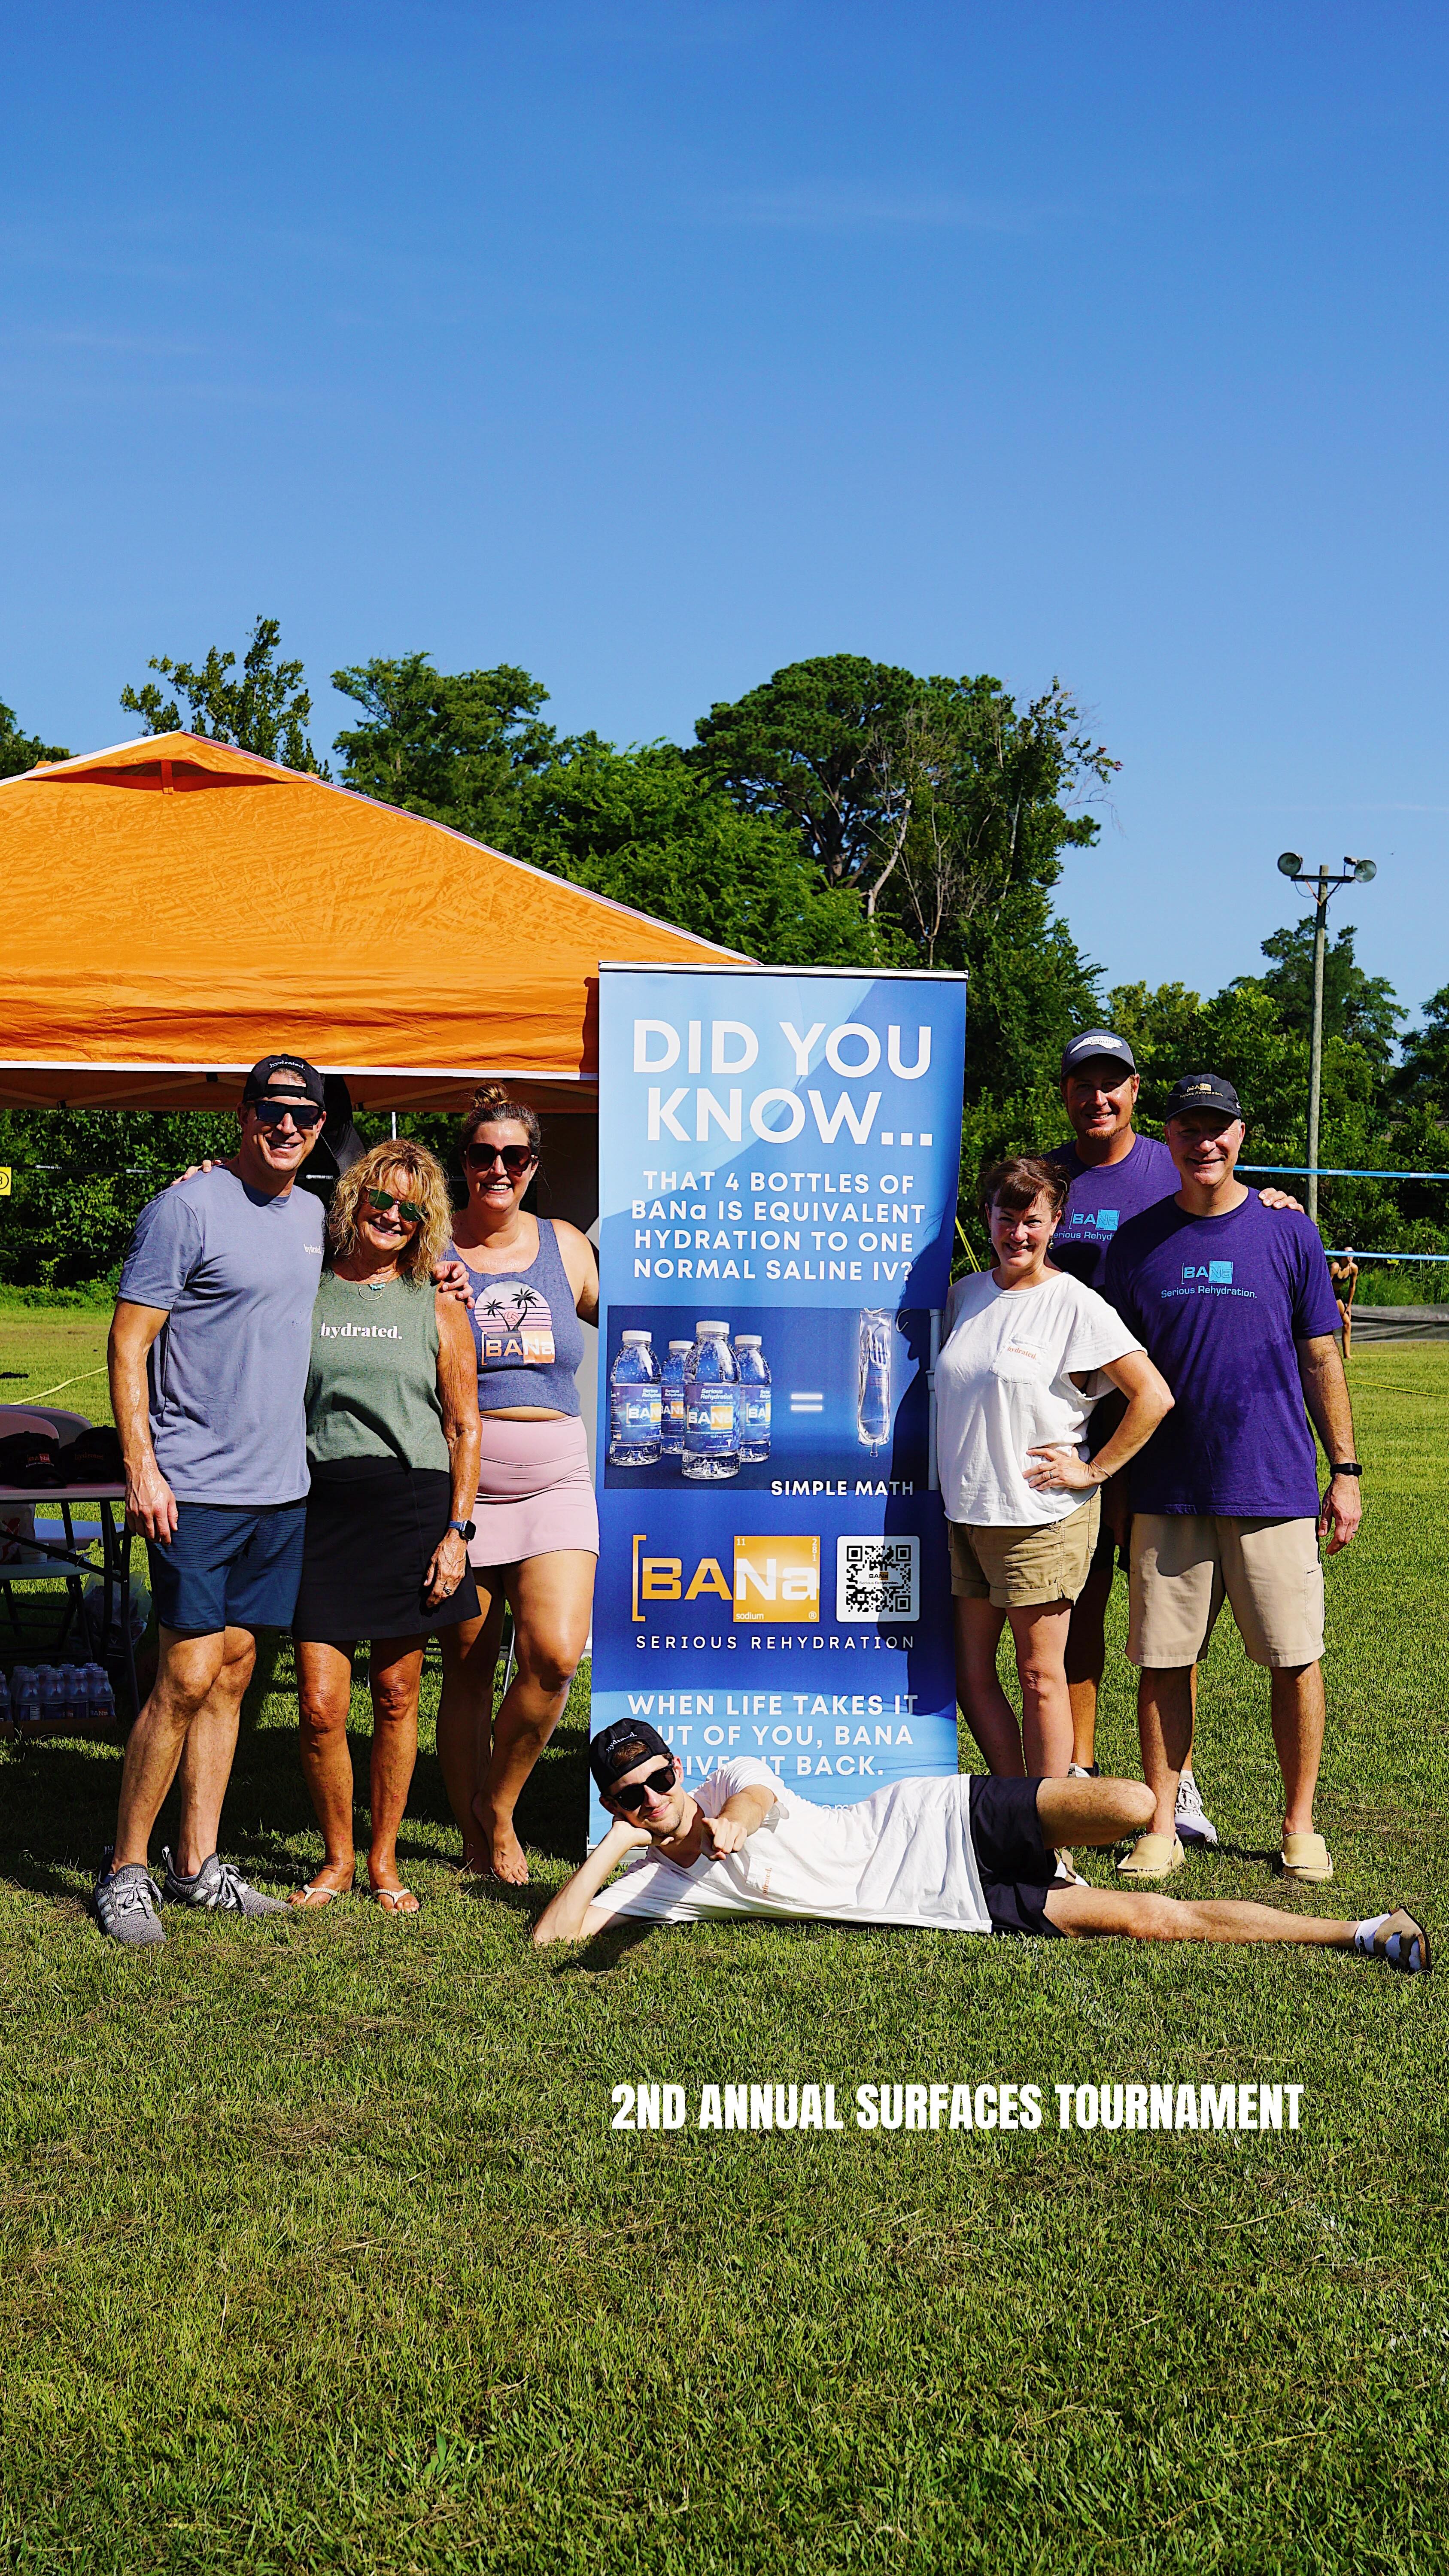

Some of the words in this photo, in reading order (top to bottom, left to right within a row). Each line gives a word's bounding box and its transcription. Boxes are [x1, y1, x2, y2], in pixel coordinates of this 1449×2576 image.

[634, 1020, 758, 1073] DID
[779, 1023, 931, 1079] YOU
[269, 1060, 305, 1071] hydrated.
[647, 1088, 933, 1146] KNOW...
[644, 1171, 715, 1191] THAT
[726, 1173, 738, 1190] 4
[751, 1173, 869, 1193] BOTTLES
[880, 1175, 913, 1194] OF
[632, 1200, 706, 1220] BANa
[719, 1201, 742, 1220] IS
[755, 1202, 925, 1223] EQUIVALENT
[635, 1230, 800, 1250] HYDRATION
[811, 1232, 847, 1251] TO
[859, 1233, 912, 1252] ONE
[635, 1259, 755, 1279] NORMAL
[767, 1260, 861, 1280] SALINE
[873, 1261, 912, 1281] IV?
[1161, 1287, 1195, 1298] Serious
[1198, 1285, 1257, 1298] Rehydration.
[320, 1323, 403, 1340] hydrated.
[772, 1481, 847, 1495] SIMPLE
[855, 1481, 913, 1496] MATH
[637, 1636, 736, 1649] SERIOUS
[752, 1636, 913, 1649] REHYDRATION
[628, 1695, 713, 1715] WHEN
[727, 1696, 781, 1715] LIFE
[793, 1695, 883, 1715] TAKES
[895, 1695, 918, 1715] IT
[657, 1725, 693, 1745] UT
[704, 1725, 740, 1745] OF
[752, 1725, 822, 1749] YOU,
[835, 1725, 913, 1745] BANA
[687, 1756, 730, 1775] IVE
[797, 1756, 883, 1775] BACK.
